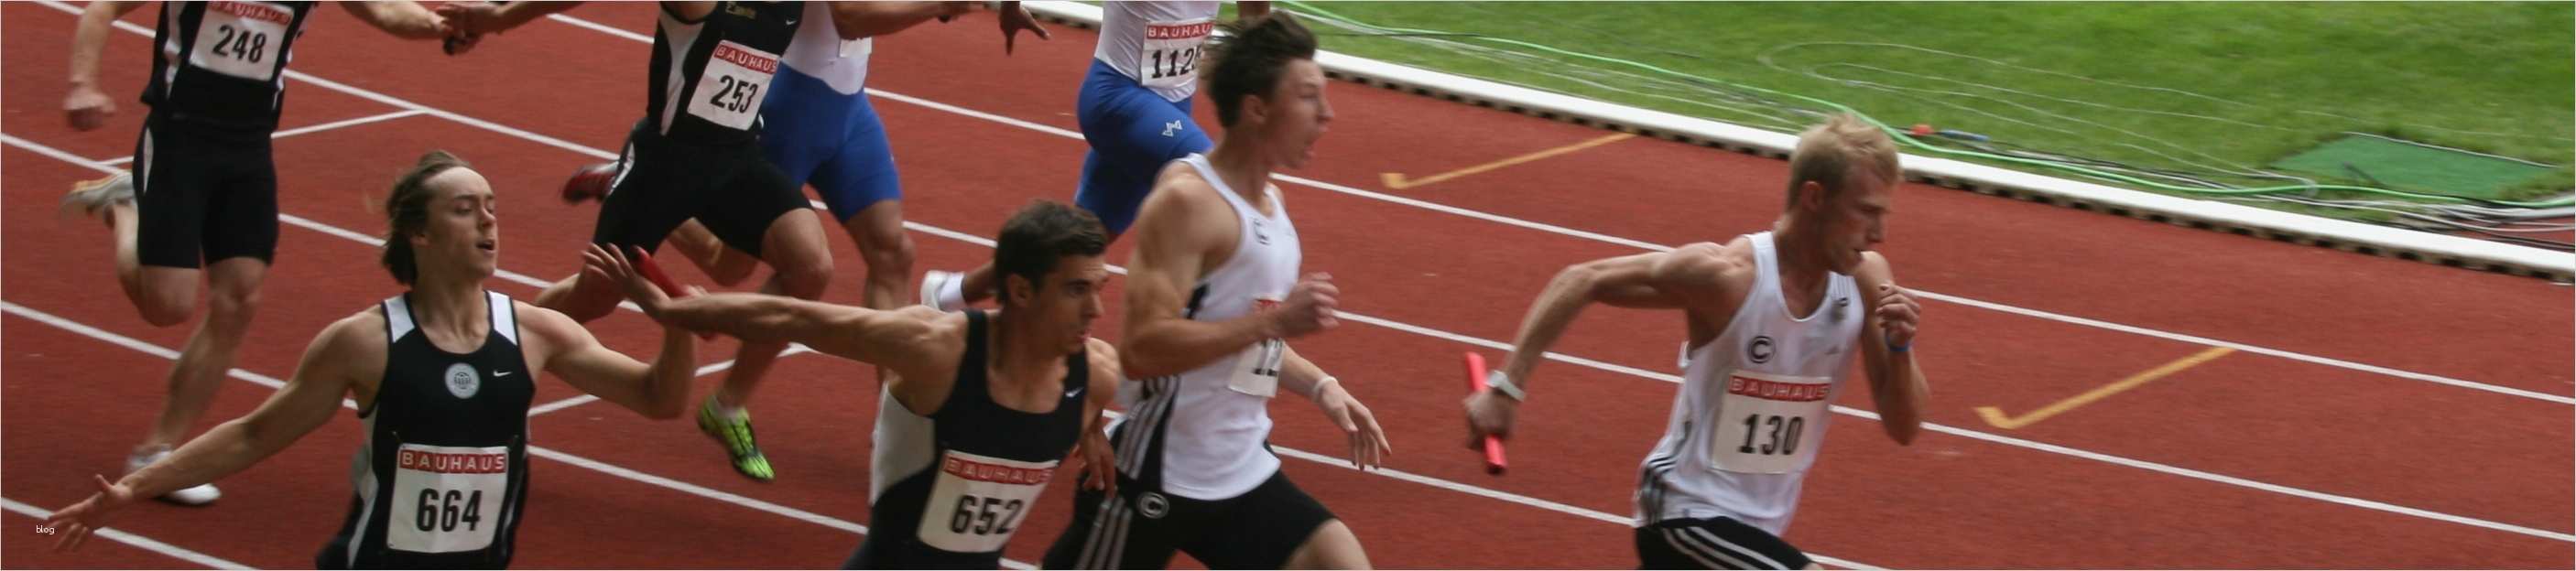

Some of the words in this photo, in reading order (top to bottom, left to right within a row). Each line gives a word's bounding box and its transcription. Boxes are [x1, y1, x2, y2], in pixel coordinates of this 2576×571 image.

[212, 24, 266, 63] 248
[1147, 24, 1211, 38] BAUHAU
[716, 47, 777, 73] BAUHAUS
[710, 75, 758, 113] 253
[1737, 414, 1805, 456] 130
[402, 452, 505, 470] BAUHAUS
[416, 488, 483, 532] 664
[950, 495, 1024, 535] 652
